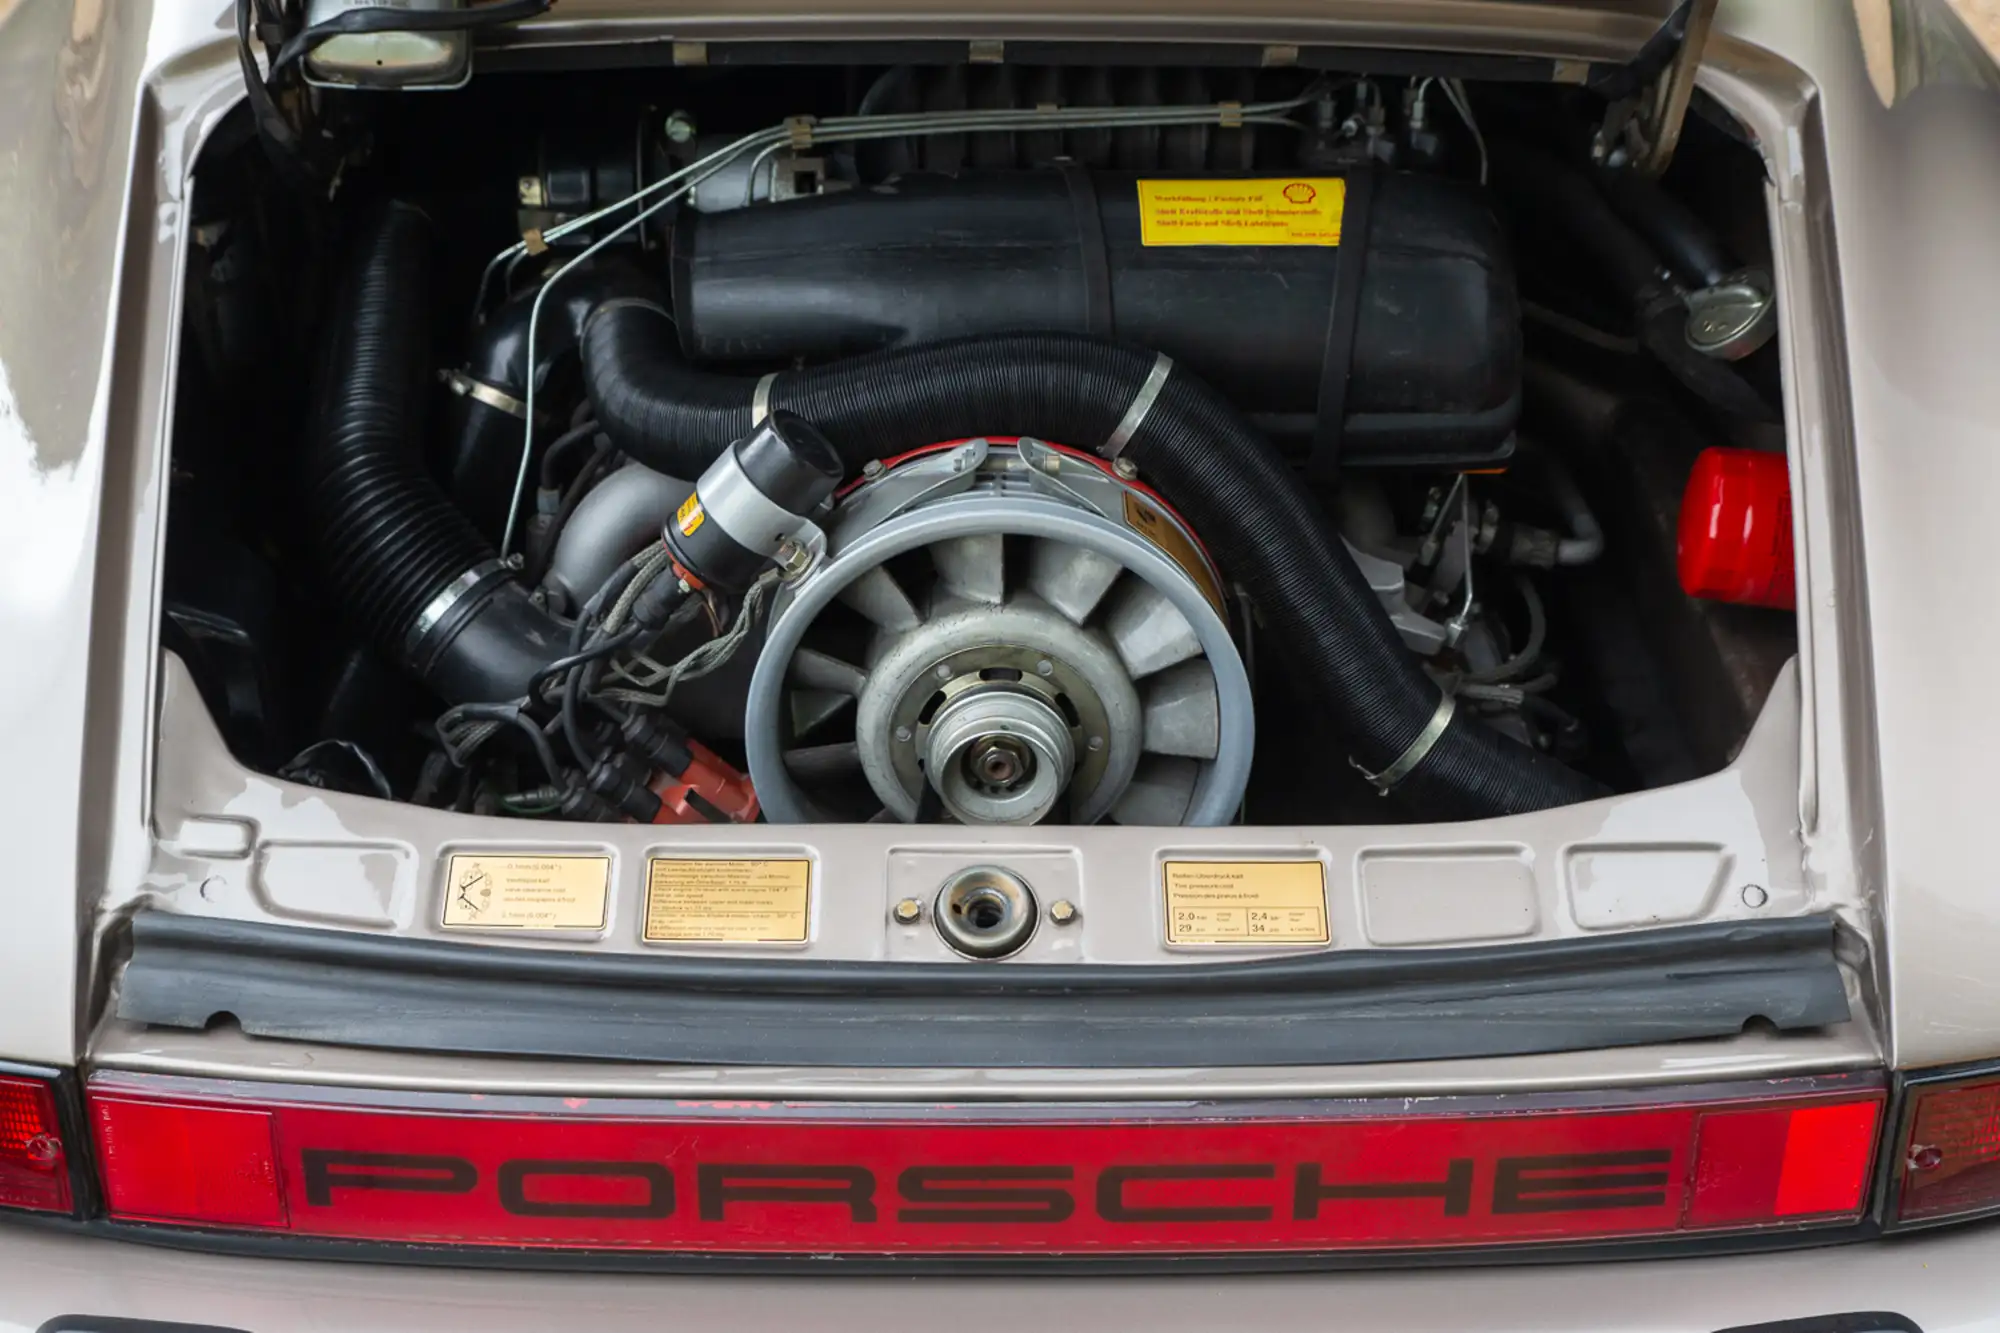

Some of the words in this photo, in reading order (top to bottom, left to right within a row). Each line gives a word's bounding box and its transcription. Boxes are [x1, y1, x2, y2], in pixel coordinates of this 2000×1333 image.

[1179, 924, 1192, 933] 29
[1252, 924, 1265, 933] 34
[301, 1148, 1672, 1224] PORSCHE
